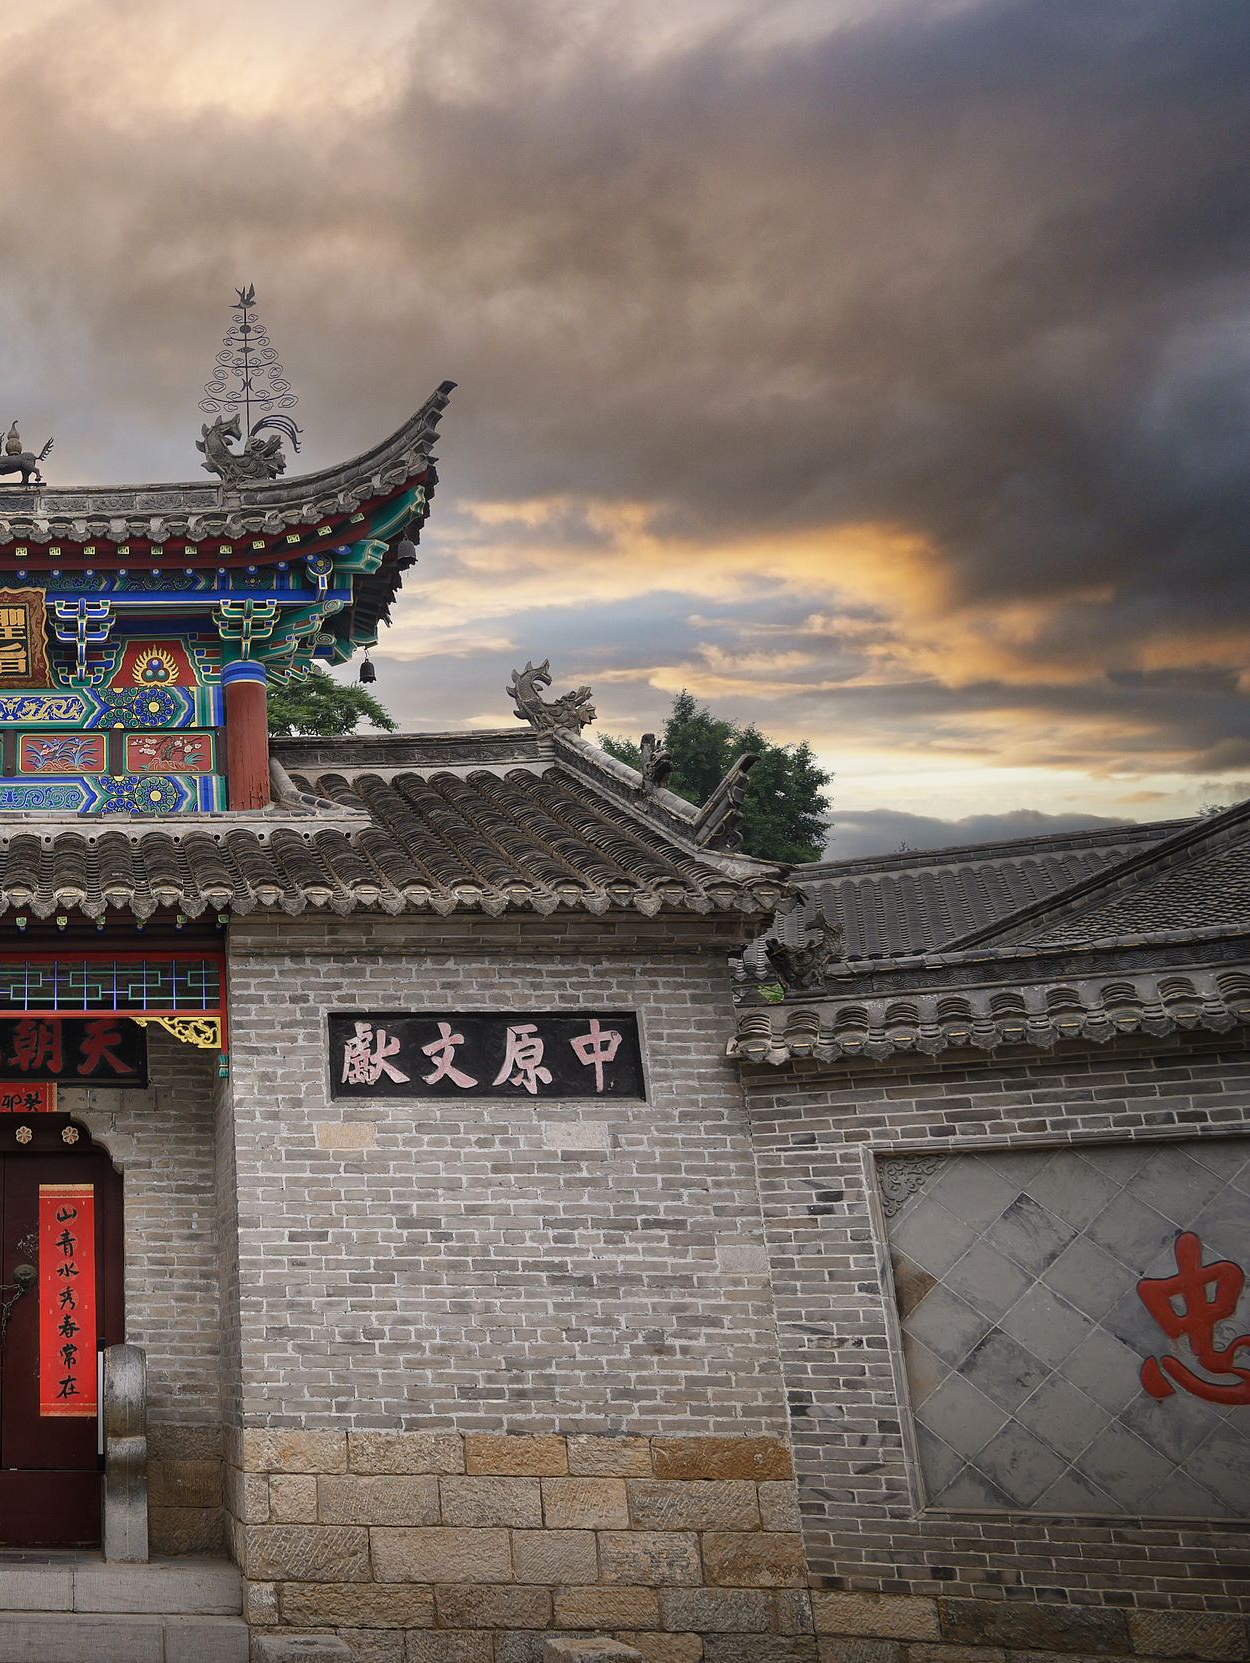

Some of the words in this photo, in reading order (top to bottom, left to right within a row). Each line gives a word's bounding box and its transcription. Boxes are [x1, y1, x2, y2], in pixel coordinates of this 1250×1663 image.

[55, 1207, 80, 1399] 山青水秀春常在
[1136, 1231, 1250, 1405] 忠
